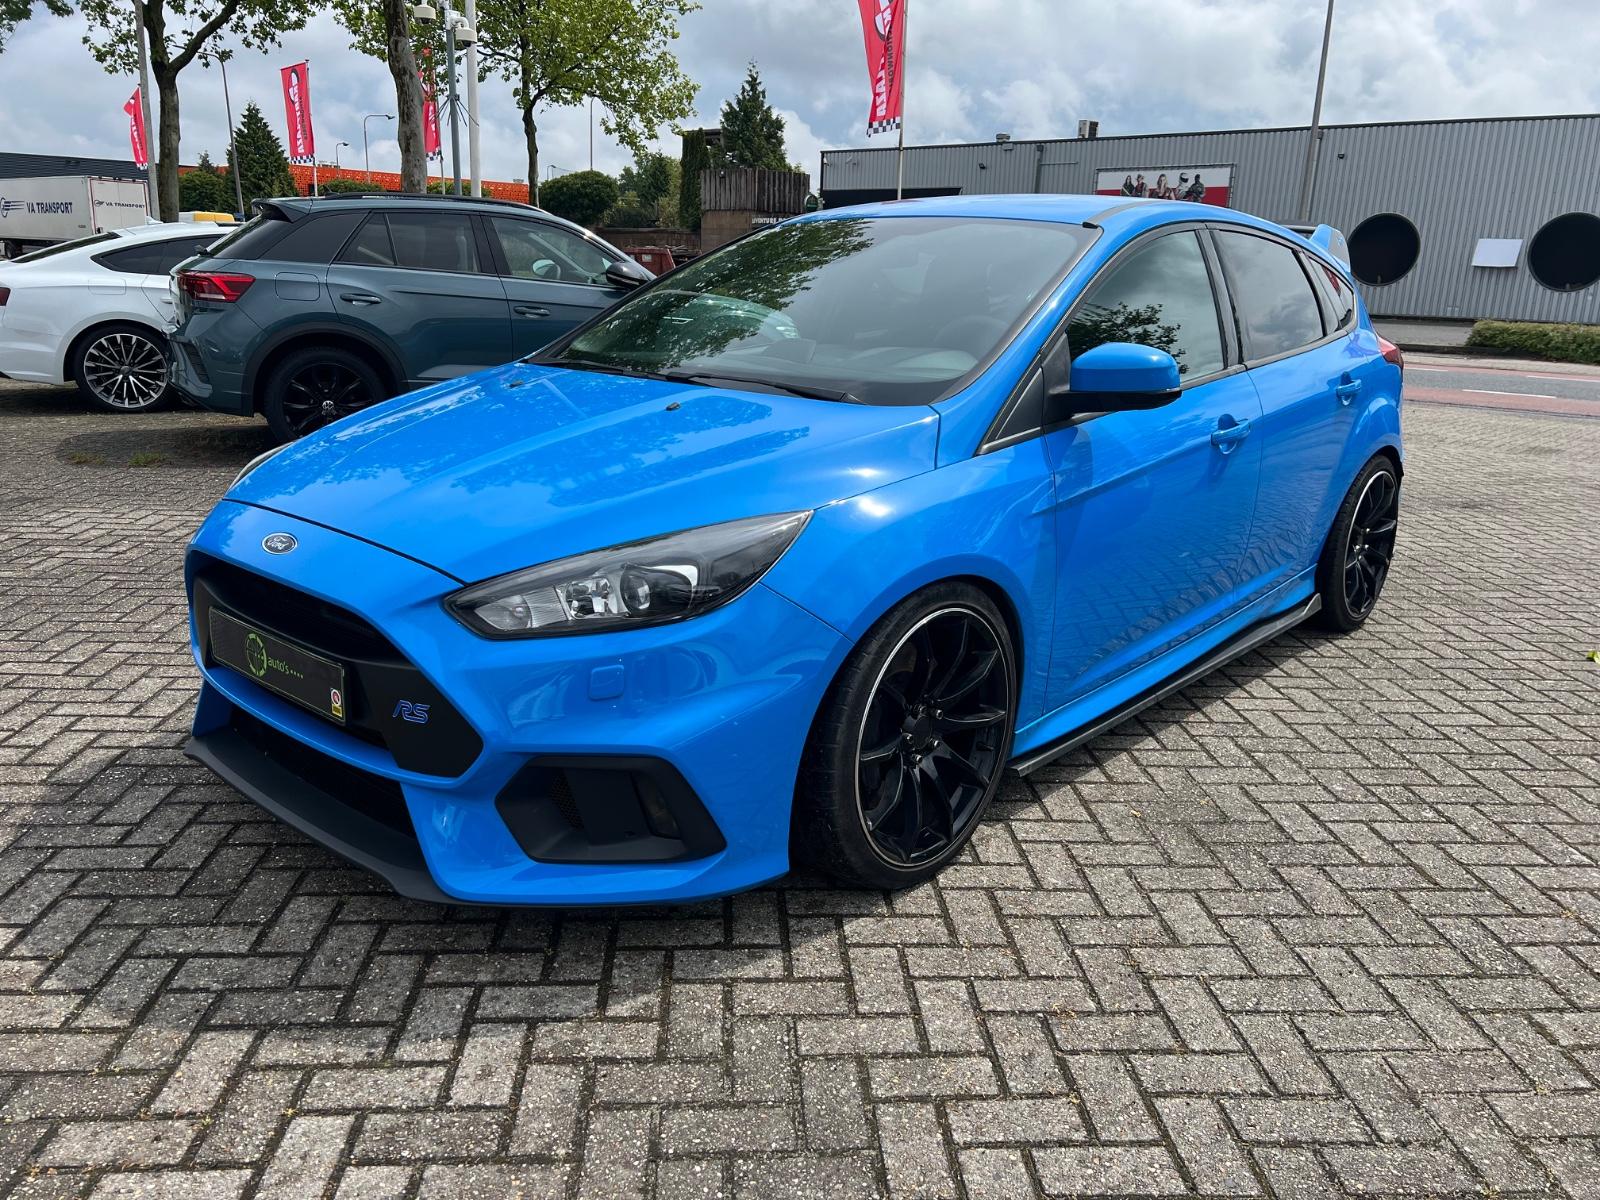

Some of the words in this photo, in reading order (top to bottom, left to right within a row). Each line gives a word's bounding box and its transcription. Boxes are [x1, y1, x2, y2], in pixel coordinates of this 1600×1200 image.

[26, 202, 36, 214] VA
[37, 201, 73, 214] TRANSPORT
[392, 699, 431, 724] RS
